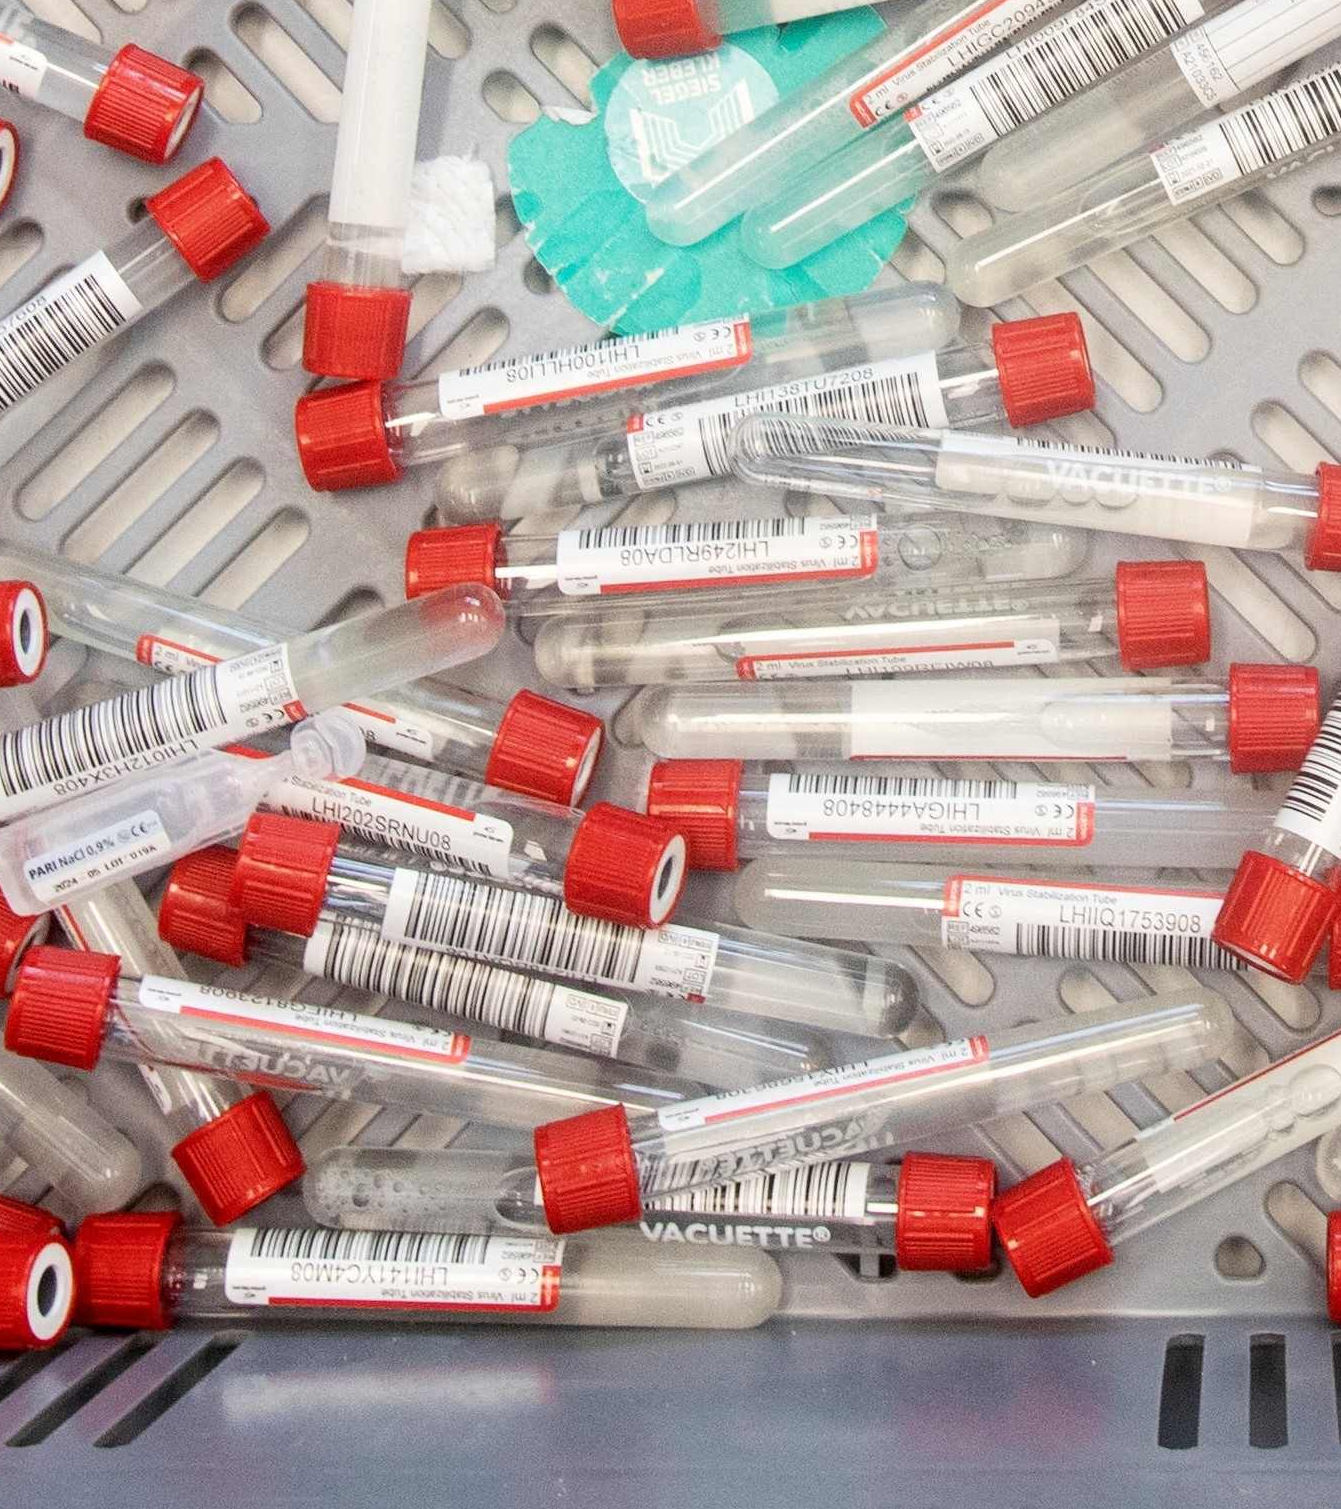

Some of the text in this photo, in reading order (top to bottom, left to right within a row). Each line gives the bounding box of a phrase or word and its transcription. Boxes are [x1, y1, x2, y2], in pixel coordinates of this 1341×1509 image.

[967, 17, 991, 37] Tube
[619, 540, 769, 565] LHI249RLDA08
[708, 565, 732, 575] Tube
[800, 558, 825, 568] Virus
[822, 799, 979, 819] LHIGA4448408
[311, 797, 453, 849] LHI202SRNU08
[919, 823, 944, 832] Tube
[1015, 825, 1039, 835] Virus
[27, 859, 58, 880] PARI
[57, 847, 87, 869] NaCl
[998, 887, 1023, 898] Virus
[1092, 895, 1117, 905] Tube
[1059, 905, 1201, 933] LHIIQ1753908
[293, 1013, 319, 1025] Tube
[812, 1075, 838, 1088] Tube
